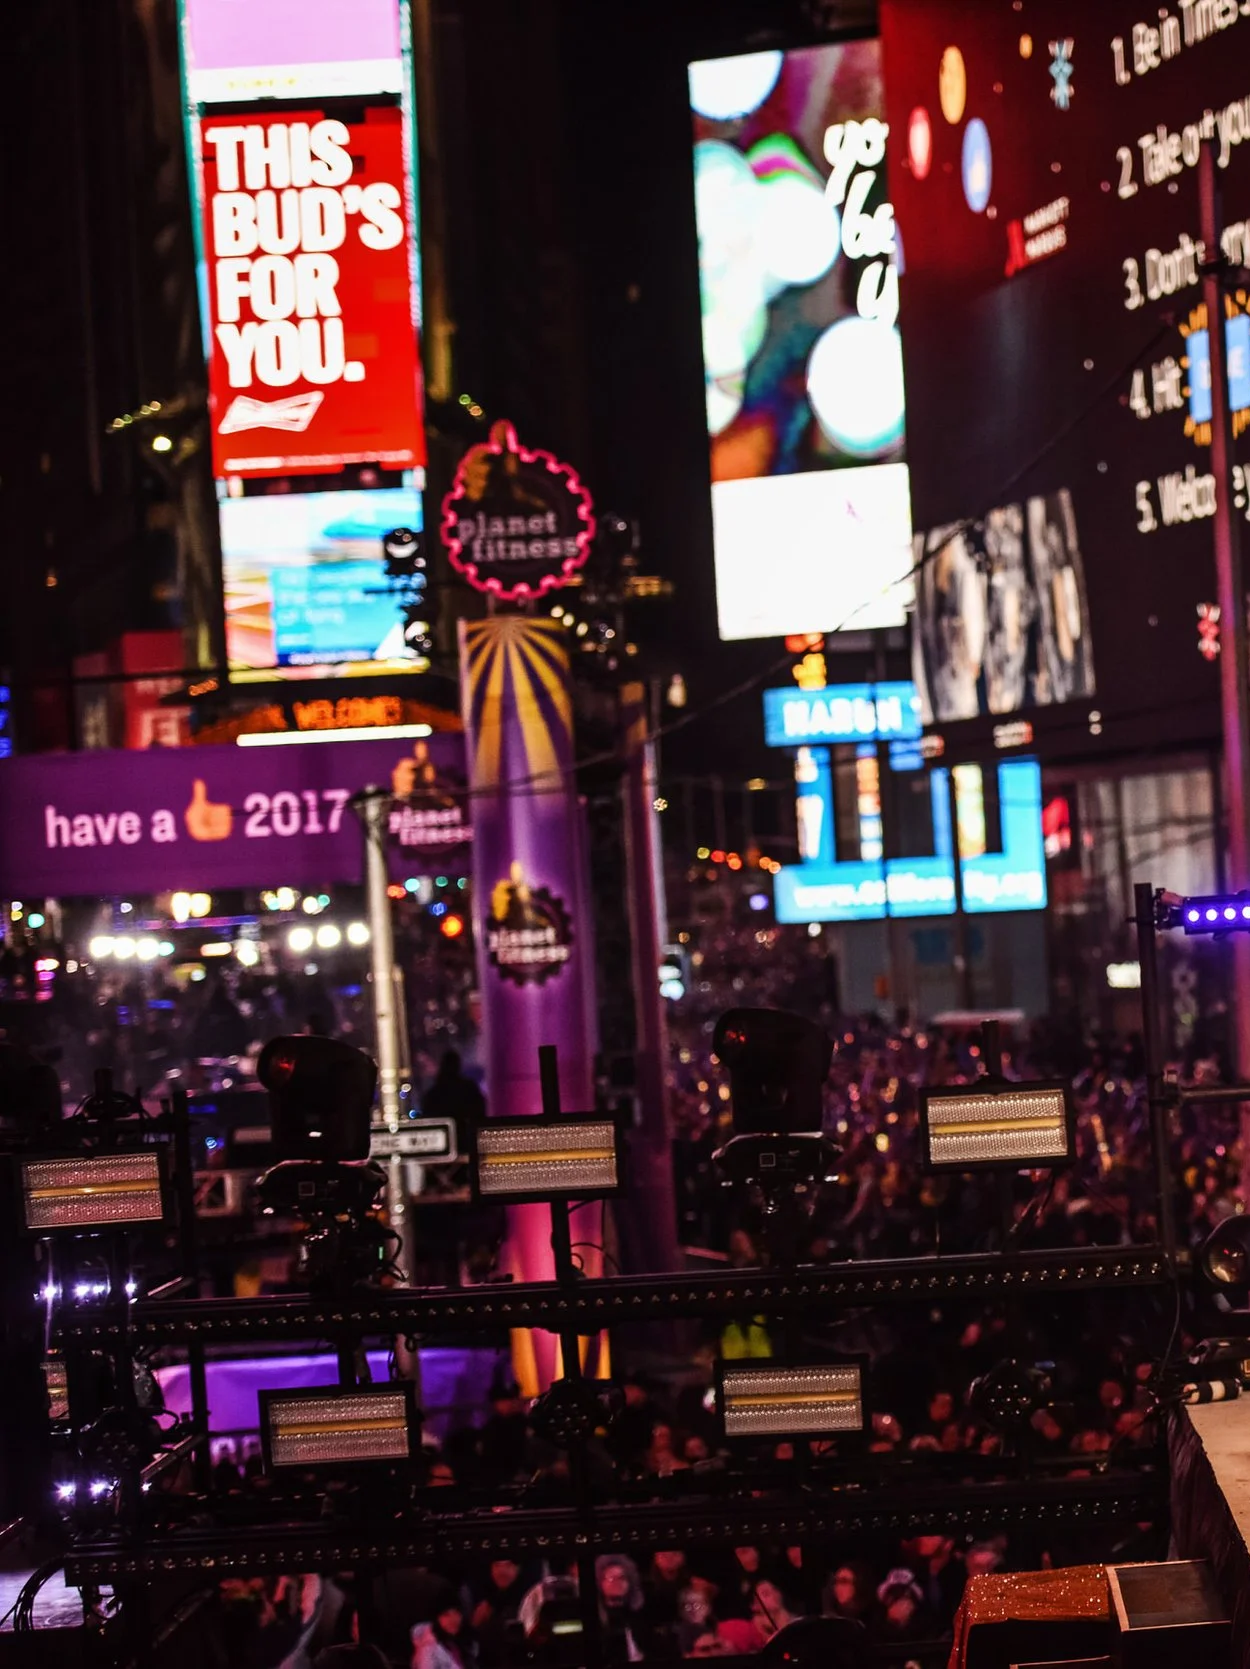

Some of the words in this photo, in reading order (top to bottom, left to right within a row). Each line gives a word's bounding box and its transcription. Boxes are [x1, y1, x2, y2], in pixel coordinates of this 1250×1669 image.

[1111, 36, 1131, 86] 1.
[1132, 22, 1161, 75] Be
[1159, 7, 1181, 61] in
[205, 119, 353, 191] THIS
[1116, 146, 1138, 199] 2.
[212, 182, 404, 257] BUD'S
[216, 252, 342, 323] FOR
[1122, 257, 1144, 310] 3.
[1145, 232, 1198, 300] Don't
[216, 317, 366, 388] YOU.
[457, 510, 557, 545] planet
[1136, 480, 1157, 533] 5.
[44, 804, 142, 848] have
[150, 809, 178, 843] a
[243, 789, 350, 838] 2017
